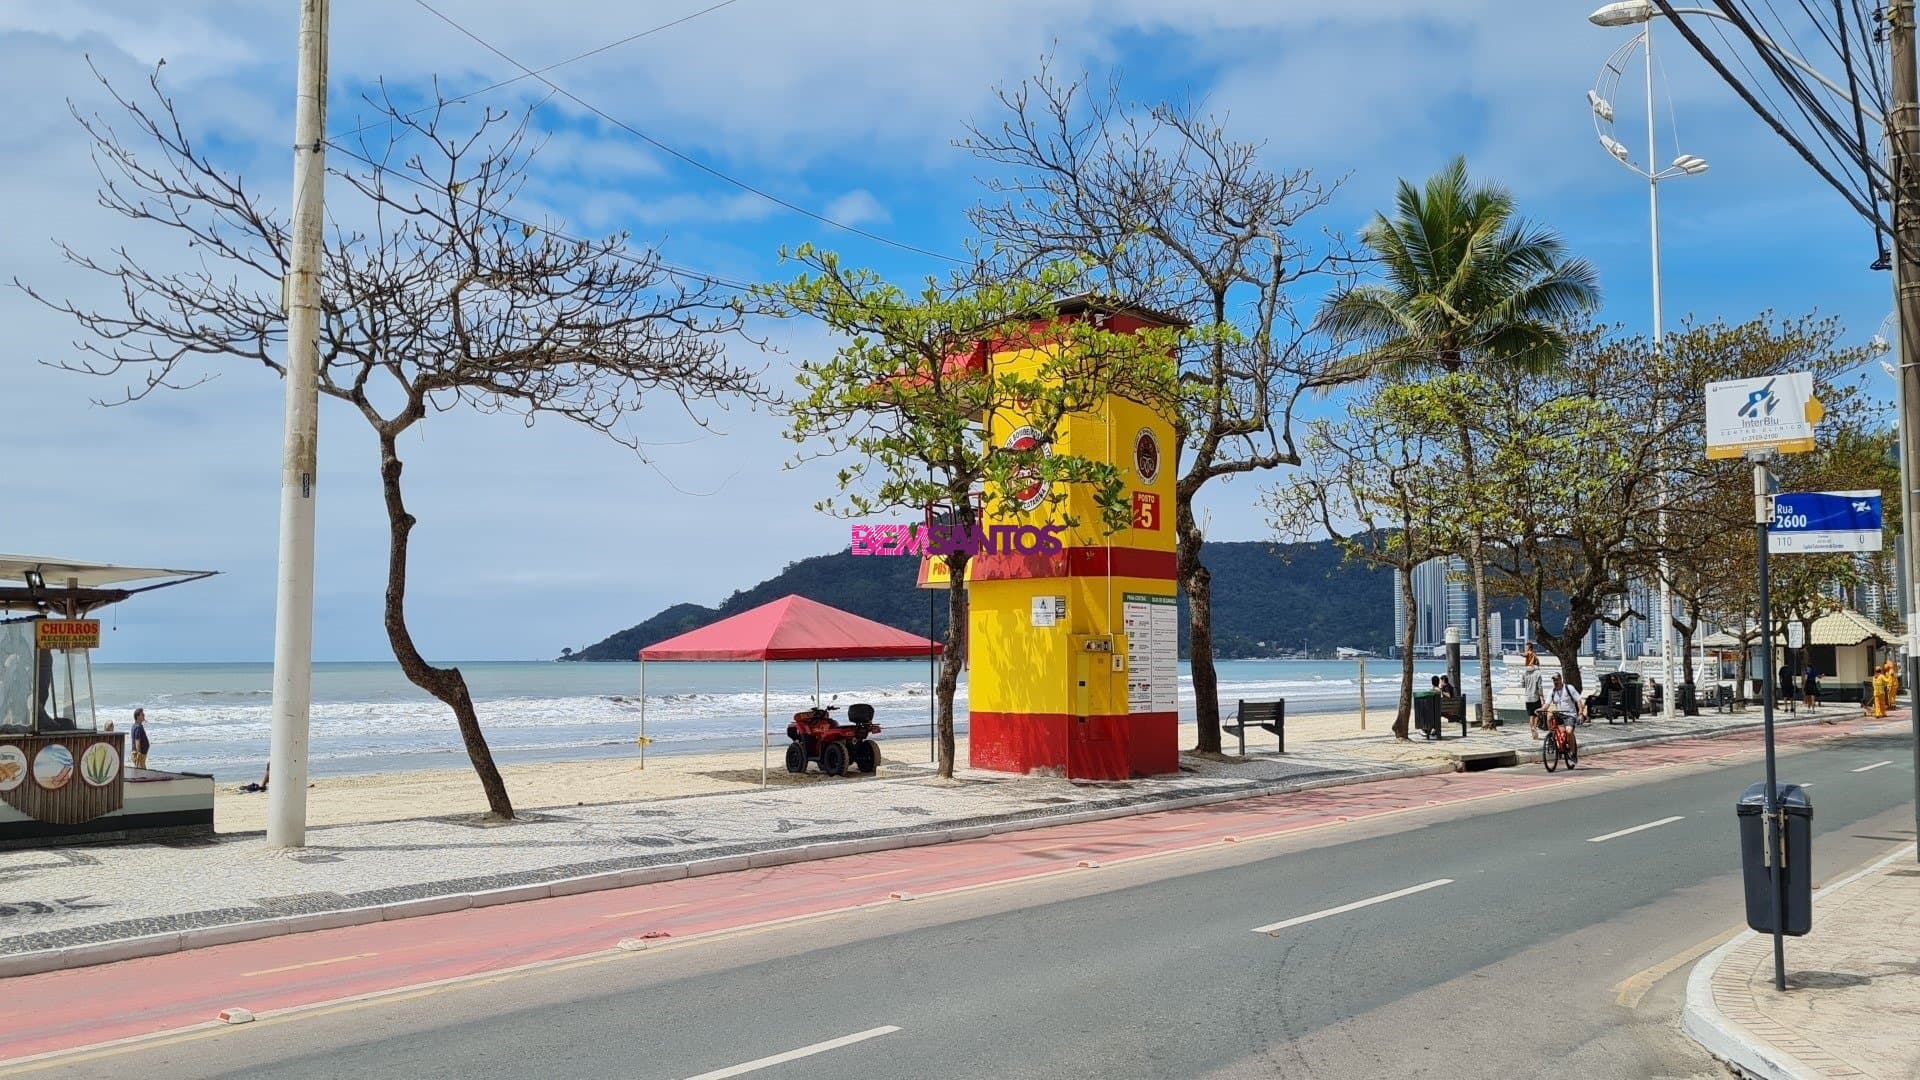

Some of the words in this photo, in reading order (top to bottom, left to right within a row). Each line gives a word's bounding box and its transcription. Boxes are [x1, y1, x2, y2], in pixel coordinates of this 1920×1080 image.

[1742, 416, 1779, 428] InterBlu
[1138, 493, 1155, 503] POSTO
[1777, 503, 1793, 514] Rua
[1141, 503, 1153, 528] 5
[1776, 514, 1807, 529] 2600
[1777, 537, 1792, 547] 110
[1859, 535, 1865, 544] 0
[41, 622, 98, 635] CHURROS
